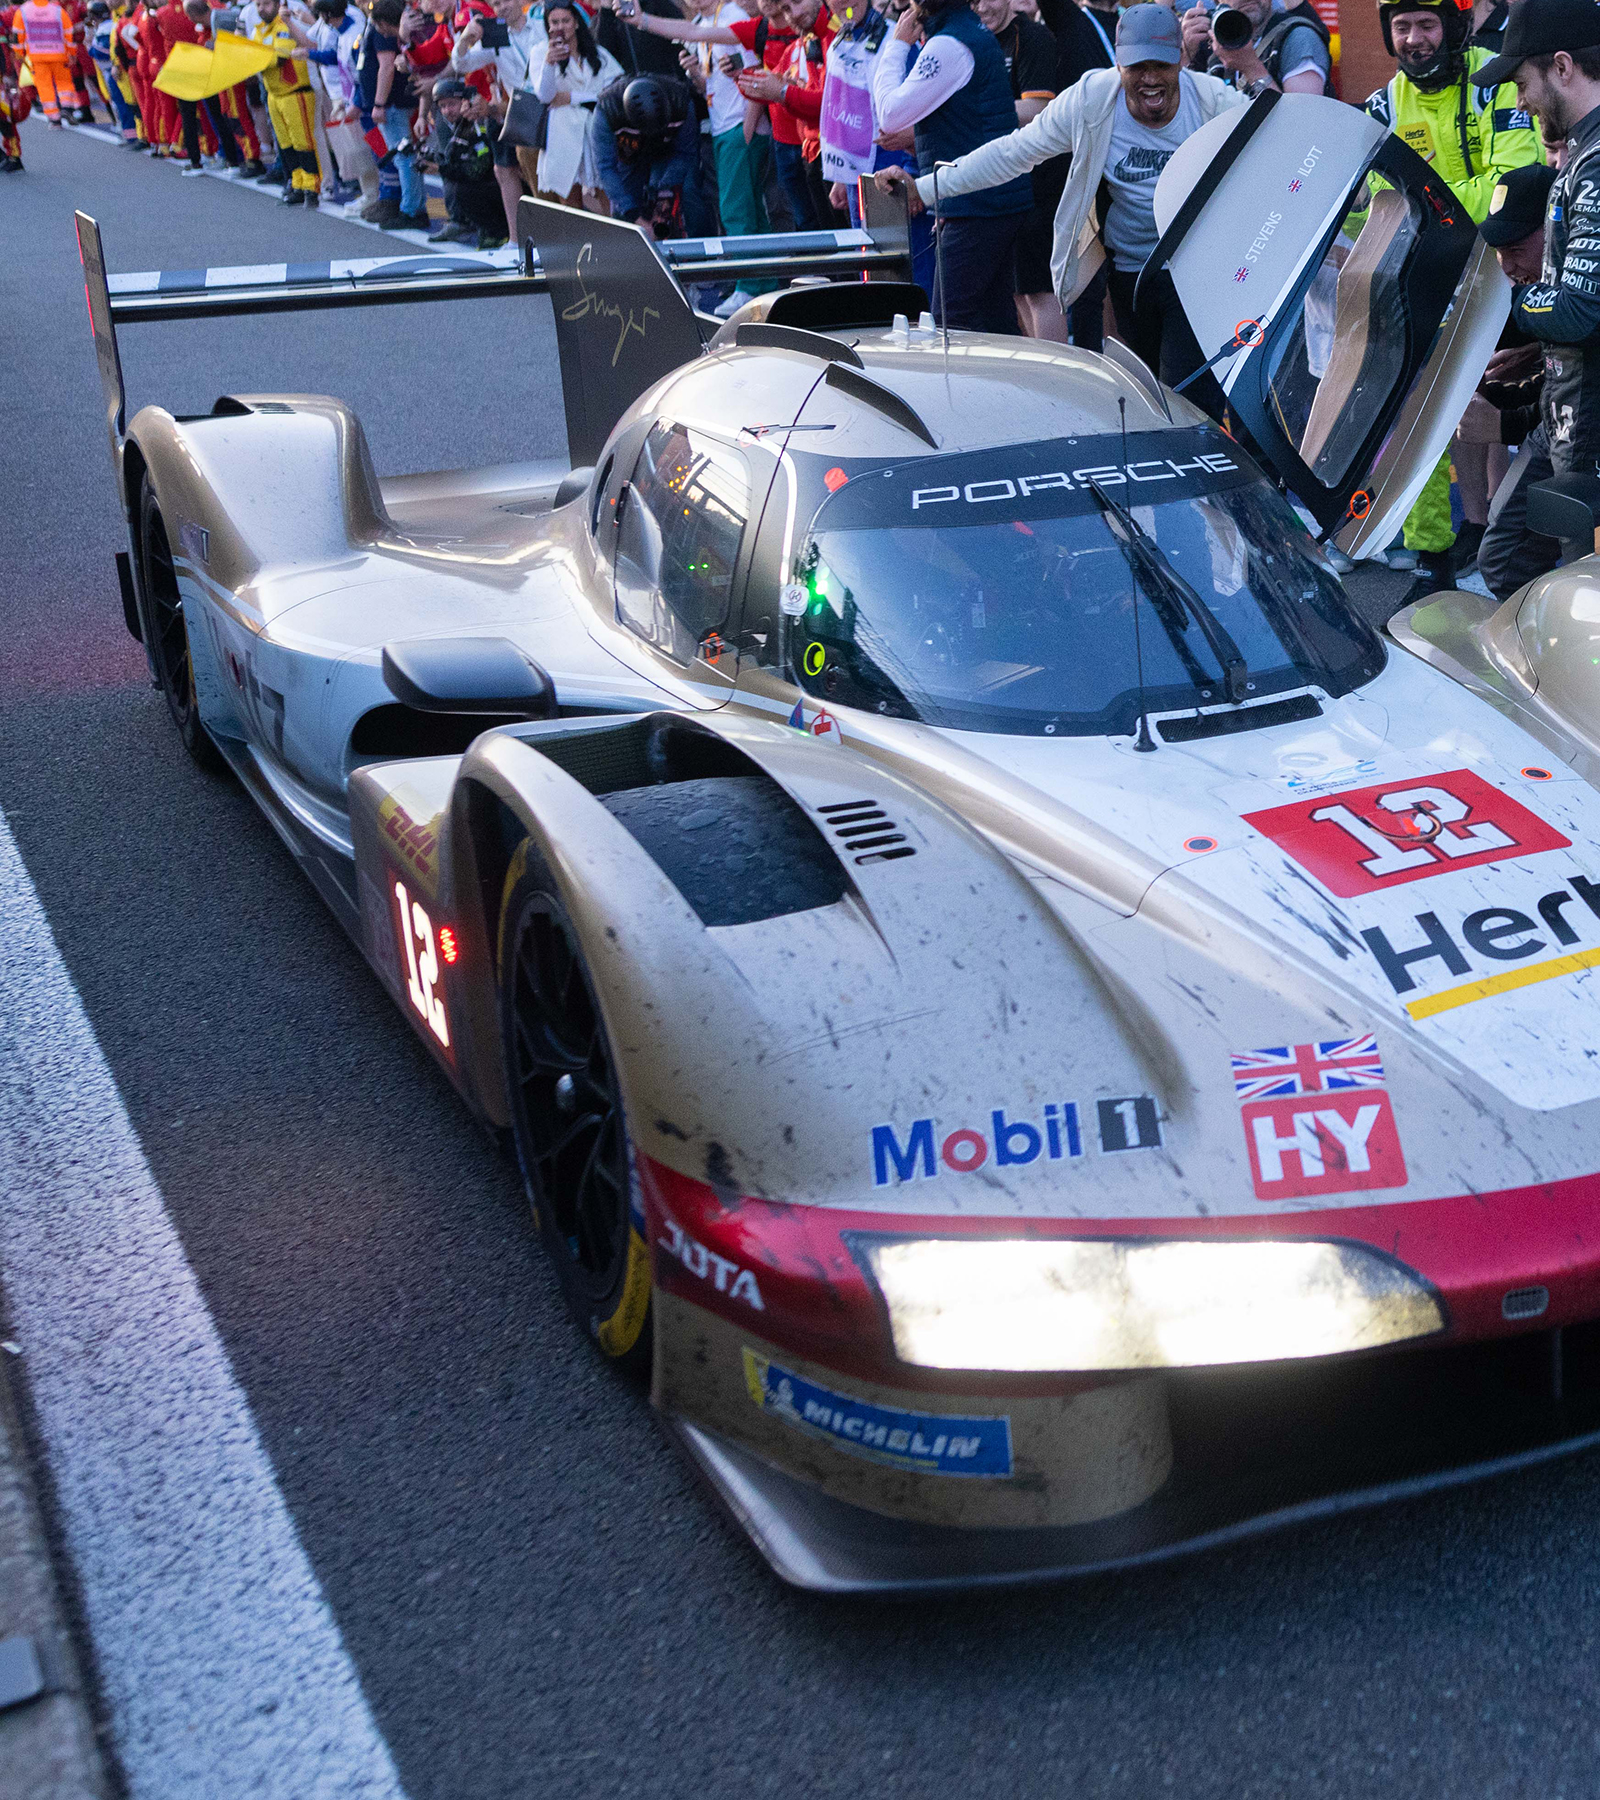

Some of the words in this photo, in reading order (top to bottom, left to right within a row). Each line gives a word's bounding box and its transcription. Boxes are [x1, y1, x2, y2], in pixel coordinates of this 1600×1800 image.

[832, 109, 863, 129] LANE
[1297, 145, 1323, 177] ILOTT
[1245, 210, 1283, 263] STEVENS
[562, 242, 660, 368] Singer
[1561, 271, 1585, 290] obil
[912, 452, 1239, 509] PORSCHE
[1307, 785, 1522, 880] 12
[395, 881, 450, 1047] 12
[871, 1101, 1083, 1188] Mobil
[1106, 1098, 1149, 1151] 1
[1252, 1103, 1382, 1182] HY
[657, 1219, 766, 1311] JOTA
[798, 1396, 983, 1460] MICHELIN
